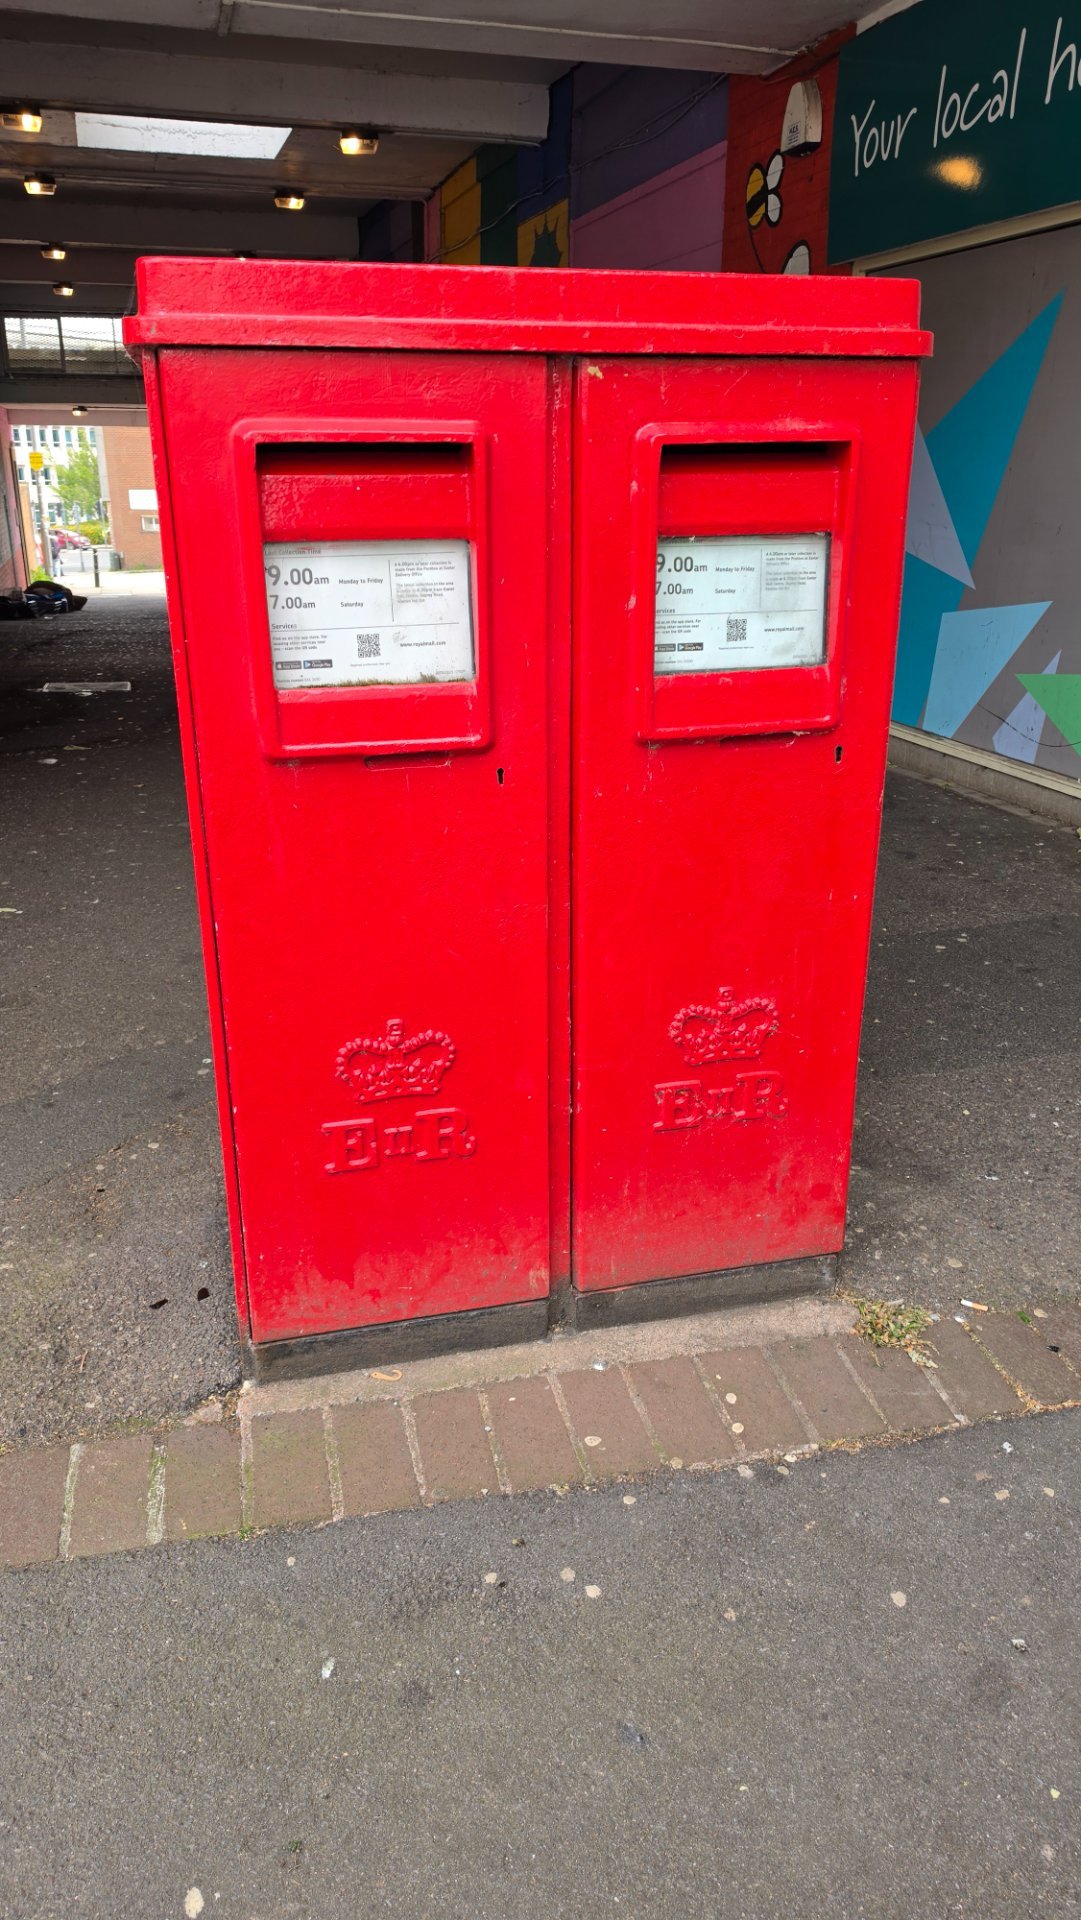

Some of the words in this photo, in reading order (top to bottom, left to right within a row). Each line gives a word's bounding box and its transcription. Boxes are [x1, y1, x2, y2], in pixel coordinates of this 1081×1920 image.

[851, 100, 918, 177] Your
[933, 28, 1027, 148] local
[1045, 17, 1081, 105] h
[267, 564, 330, 587] 9.00am
[740, 565, 755, 573] Friday
[338, 578, 360, 586] Monday
[367, 577, 384, 585] Friday
[269, 594, 316, 610] 7.00am
